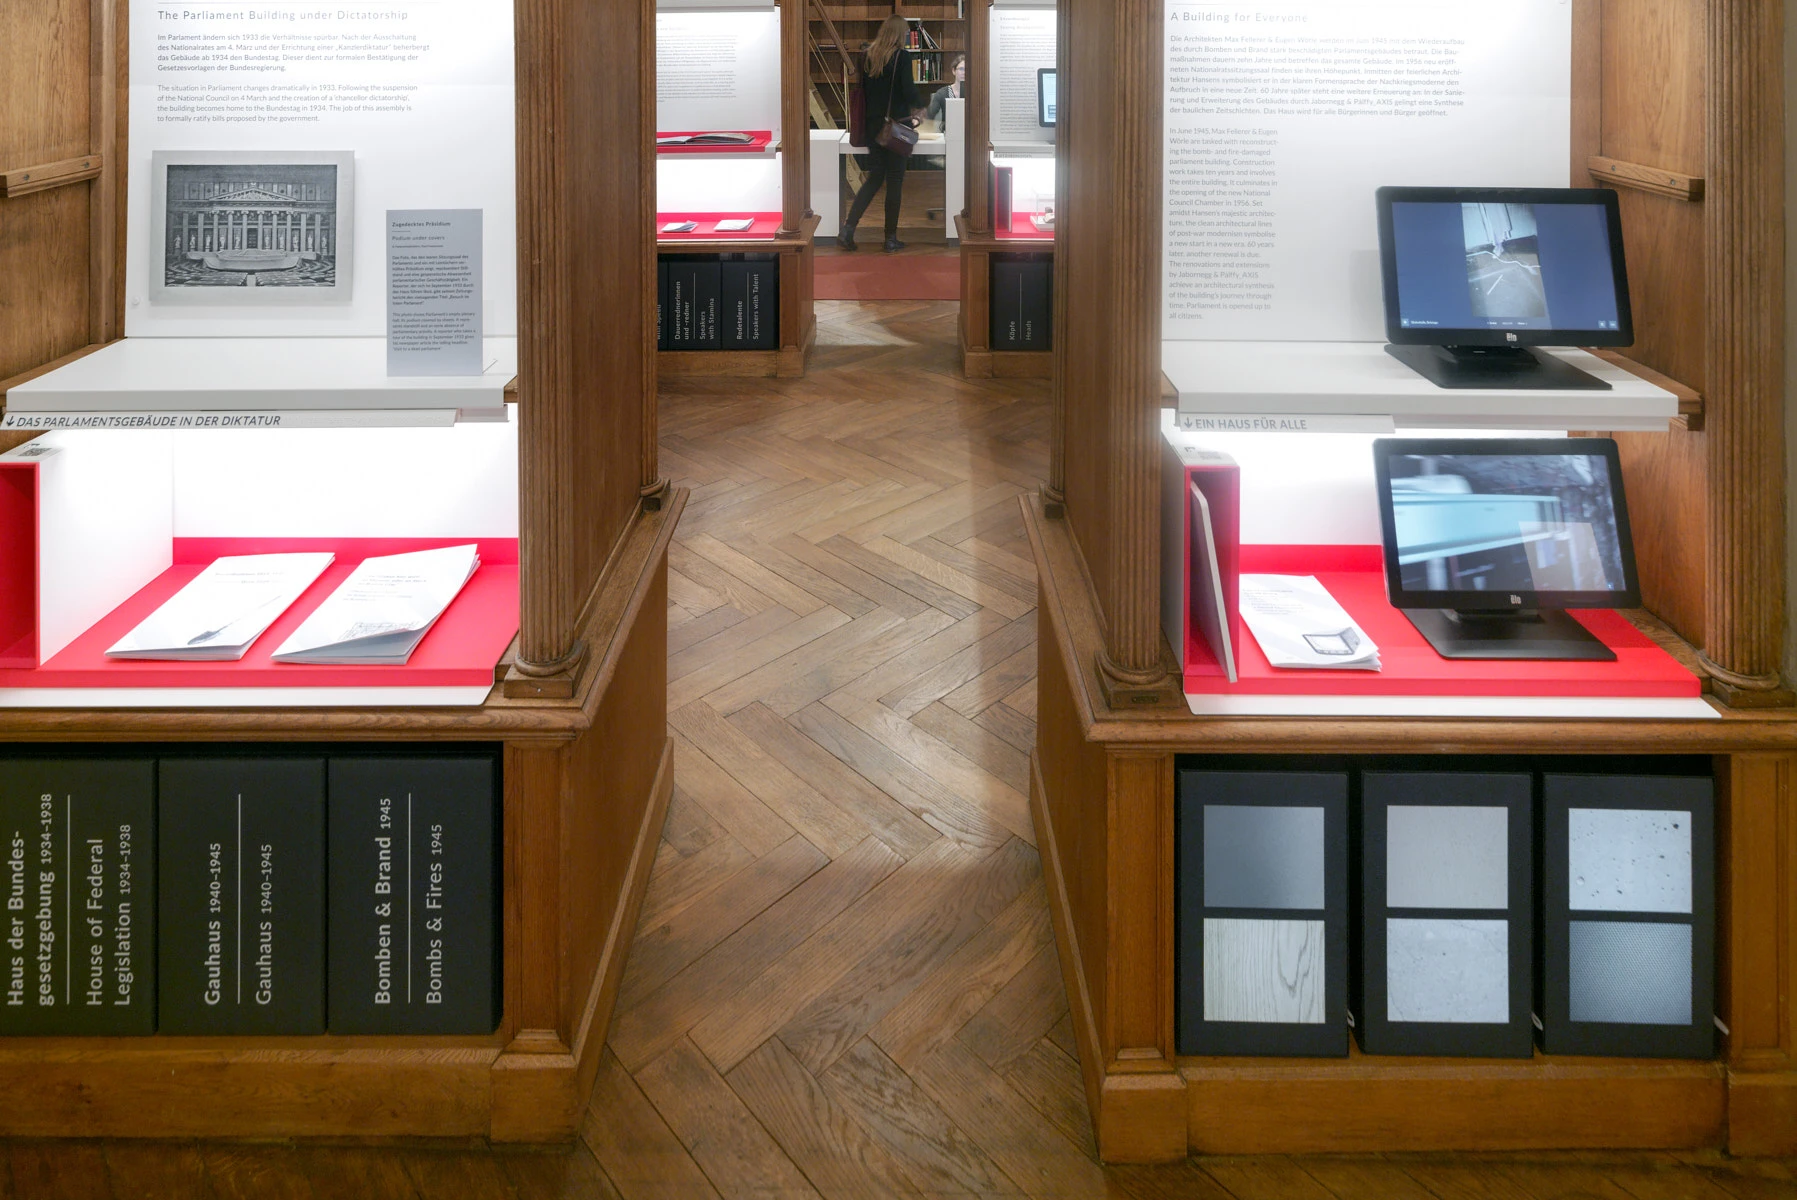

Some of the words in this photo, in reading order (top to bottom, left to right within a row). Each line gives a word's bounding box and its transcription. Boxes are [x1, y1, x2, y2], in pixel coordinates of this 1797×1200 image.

[158, 11, 178, 20] The
[183, 11, 244, 20] Parliament
[249, 11, 296, 21] Building
[300, 11, 332, 20] under
[338, 10, 408, 20] Dictatorship
[1170, 12, 1179, 21] A
[1183, 12, 1230, 23] Building
[1234, 12, 1250, 22] for
[1255, 13, 1308, 22] Everyone
[16, 417, 41, 427] DAS
[42, 414, 178, 426] PARLAMENTSGEBÄUDE
[180, 416, 193, 426] IN
[195, 415, 218, 426] DER
[221, 415, 281, 426] DIKTATUR
[1195, 418, 1214, 429] EIN
[1218, 419, 1251, 429] HAUS
[1254, 417, 1277, 429] FÜR
[1280, 420, 1307, 430] ALLE
[41, 794, 53, 864] 1934-1938
[380, 798, 391, 828] 1945
[430, 824, 442, 854] 1945
[8, 830, 24, 910] Bundes-
[86, 840, 103, 910] Federal
[119, 824, 132, 894] 1934-1938
[210, 844, 222, 912] 1940-1945
[260, 844, 272, 914] 1940-1945
[374, 838, 391, 894] Brand
[426, 862, 442, 908] Fires
[8, 918, 24, 950] der
[86, 918, 103, 938] of
[374, 902, 391, 916] &
[426, 918, 442, 932] &
[36, 872, 56, 1006] gesetzgebung
[114, 902, 134, 1006] Legislation
[204, 920, 221, 1006] Gauhaus
[256, 922, 272, 1004] Gauhaus
[374, 924, 391, 1004] Bomben
[8, 956, 24, 1006] Haus
[86, 944, 103, 1004] House
[426, 940, 442, 1004] Bombs
